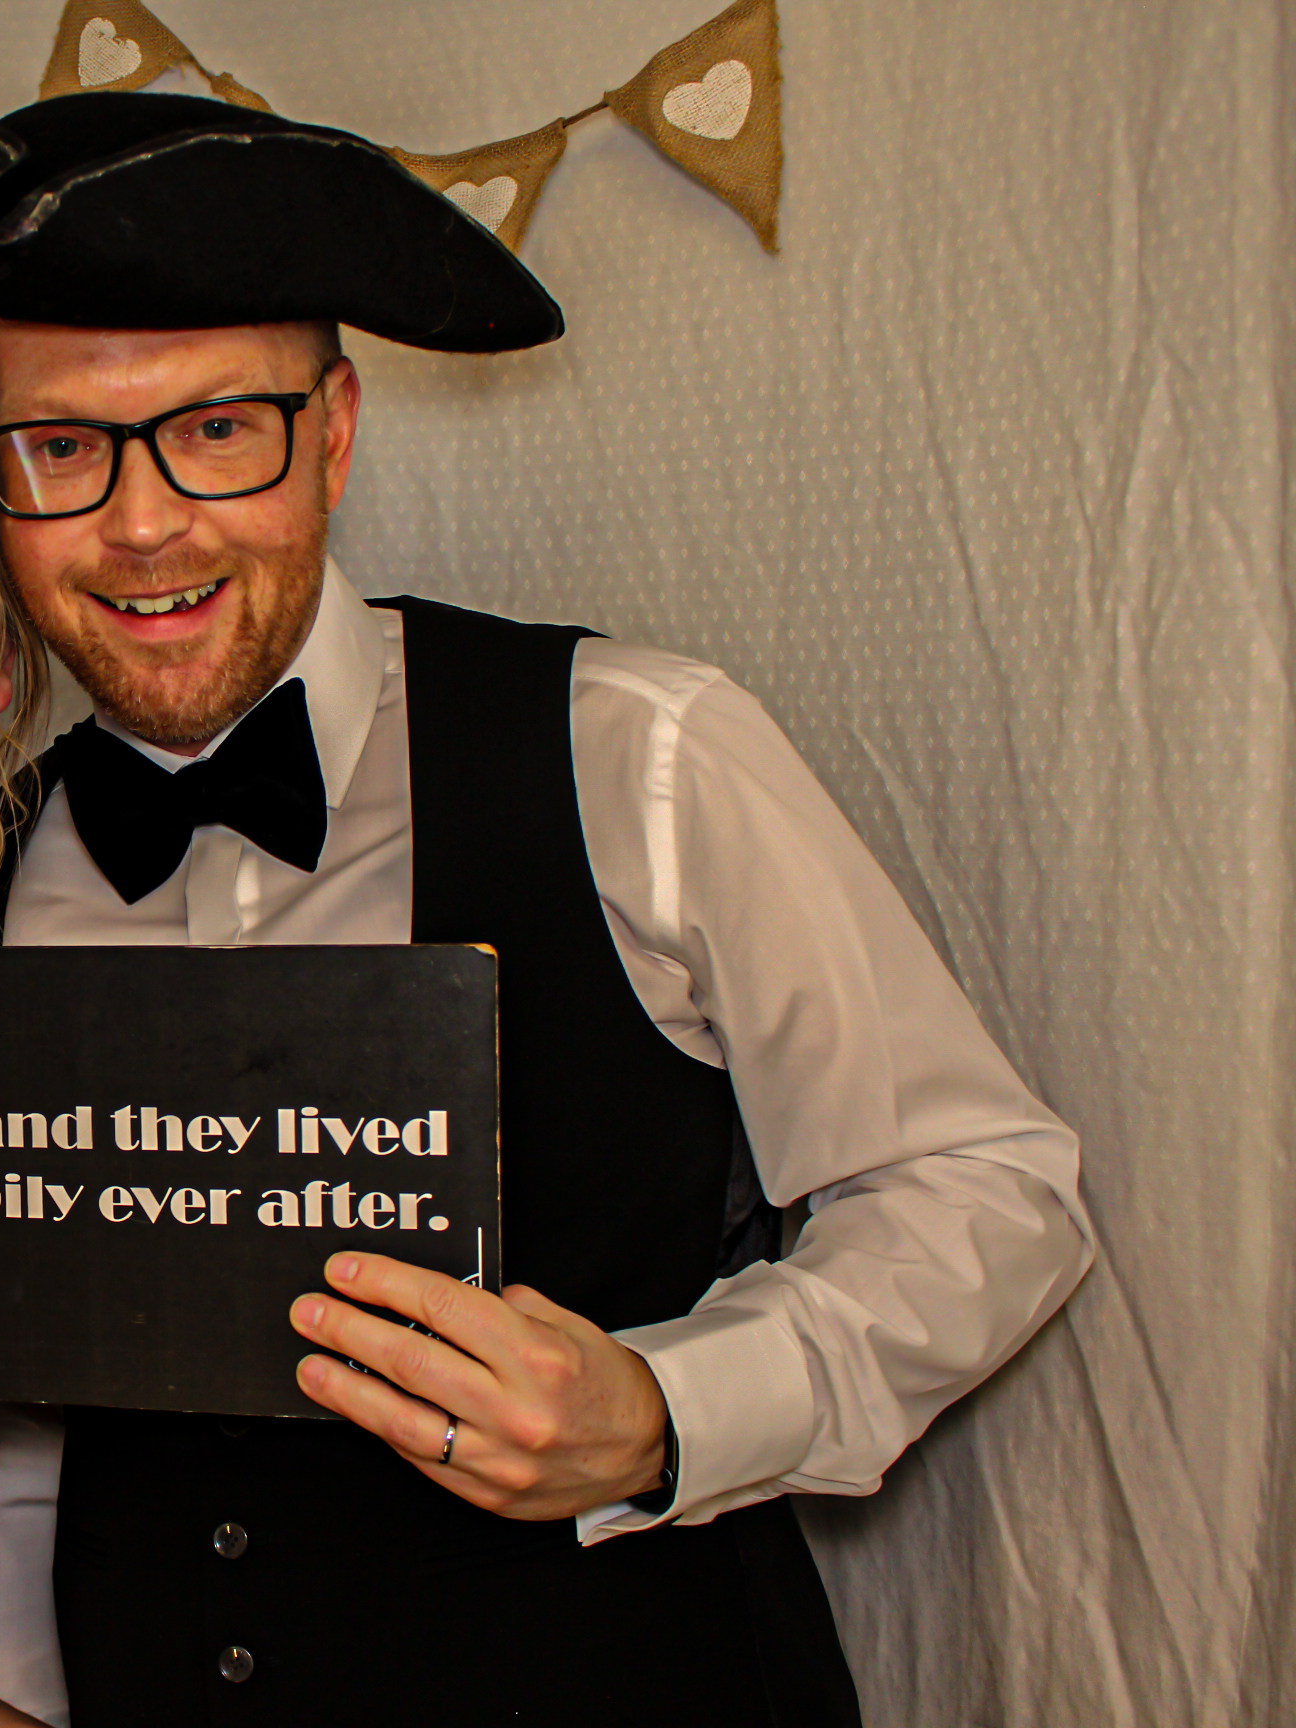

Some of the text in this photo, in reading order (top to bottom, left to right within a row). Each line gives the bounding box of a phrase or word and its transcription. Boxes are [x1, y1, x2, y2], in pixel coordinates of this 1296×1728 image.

[109, 1104, 261, 1154] they
[277, 1106, 448, 1157] lived
[98, 1185, 242, 1225] ever
[257, 1180, 450, 1231] after.
